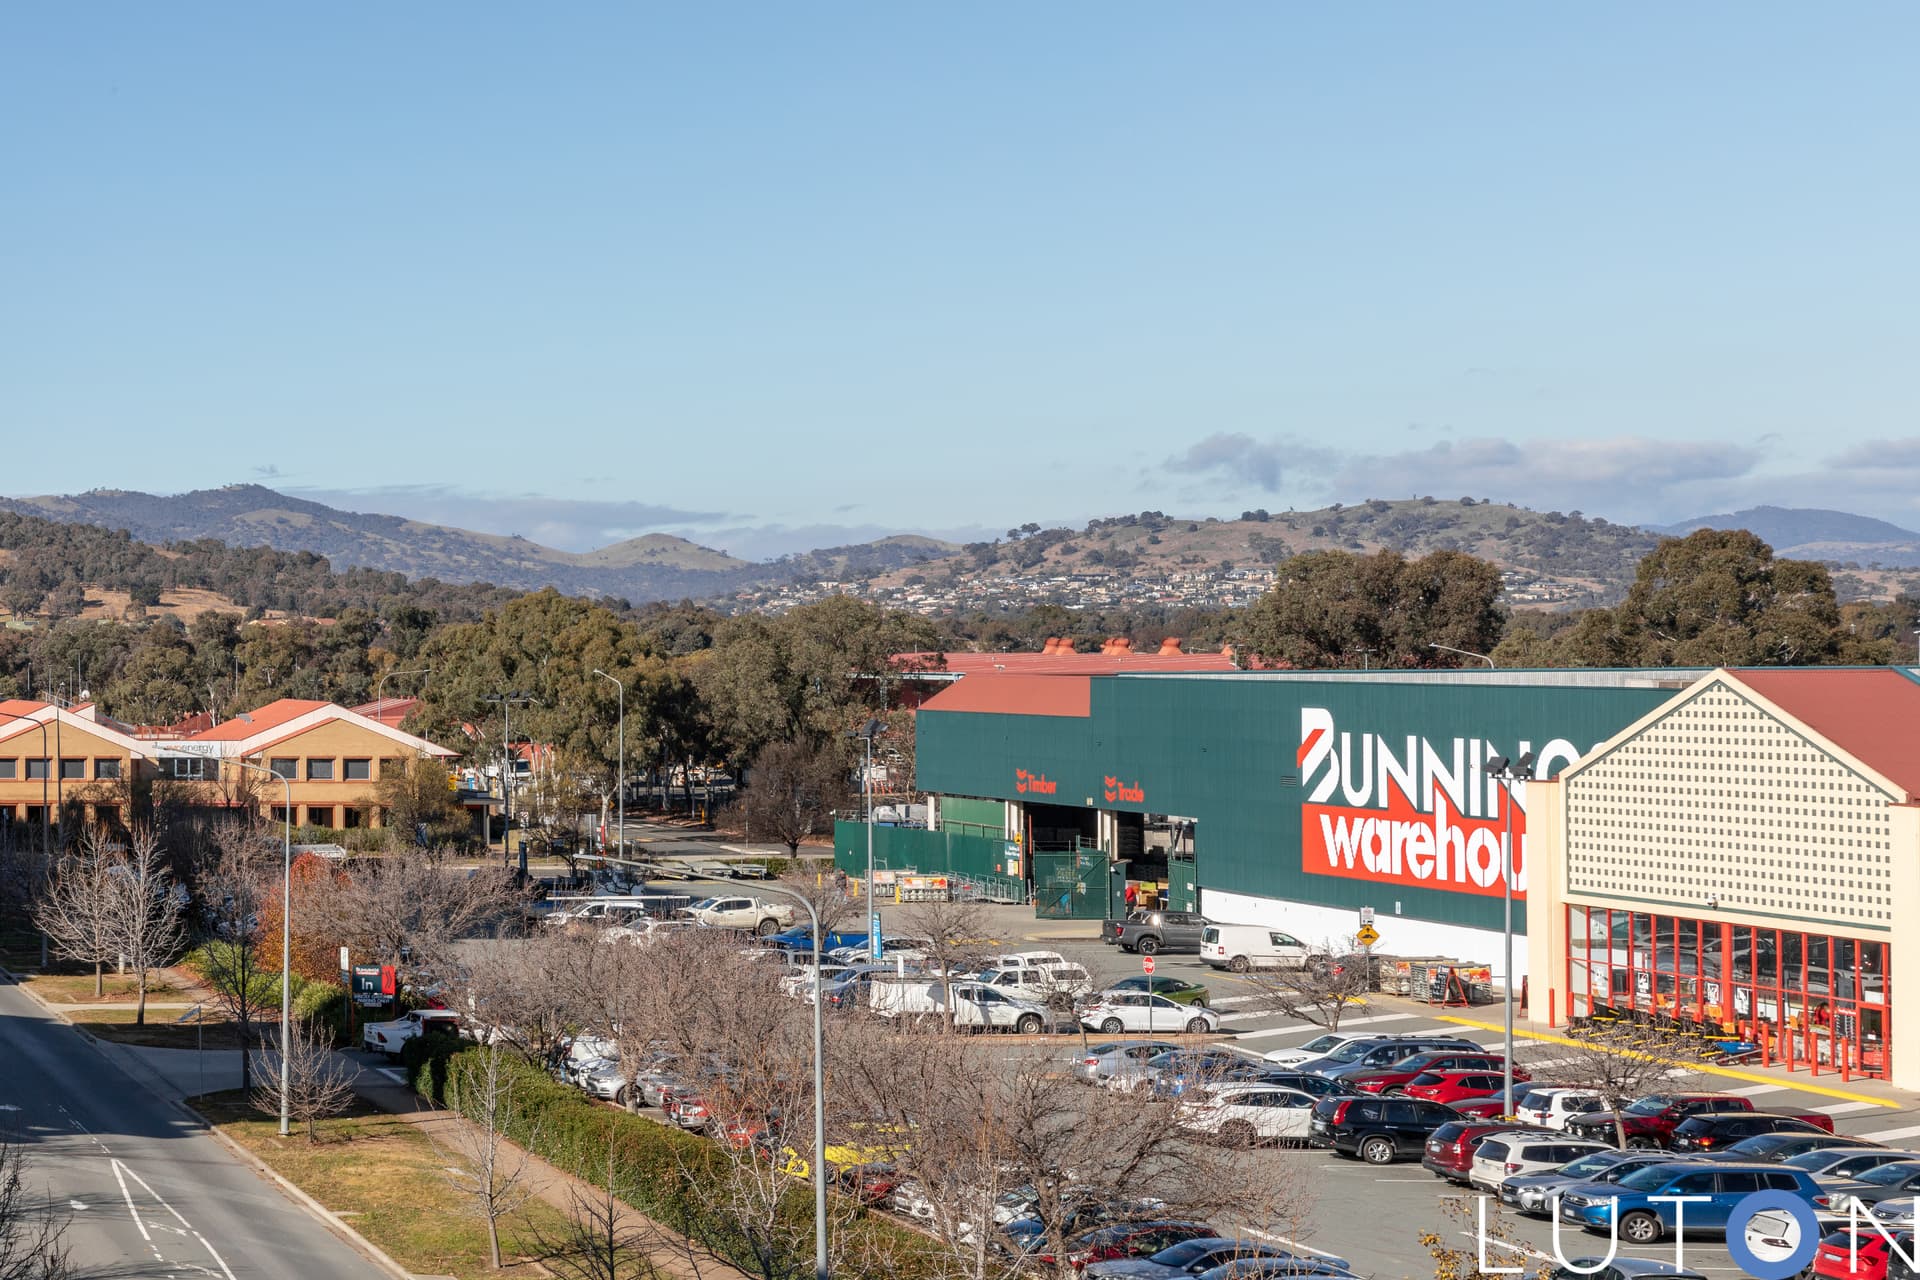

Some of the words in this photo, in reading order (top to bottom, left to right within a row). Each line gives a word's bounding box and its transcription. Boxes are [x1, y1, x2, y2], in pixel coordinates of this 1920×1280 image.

[1297, 707, 1606, 819] BUNNIN
[1319, 787, 1527, 892] warehou
[361, 977, 373, 990] In
